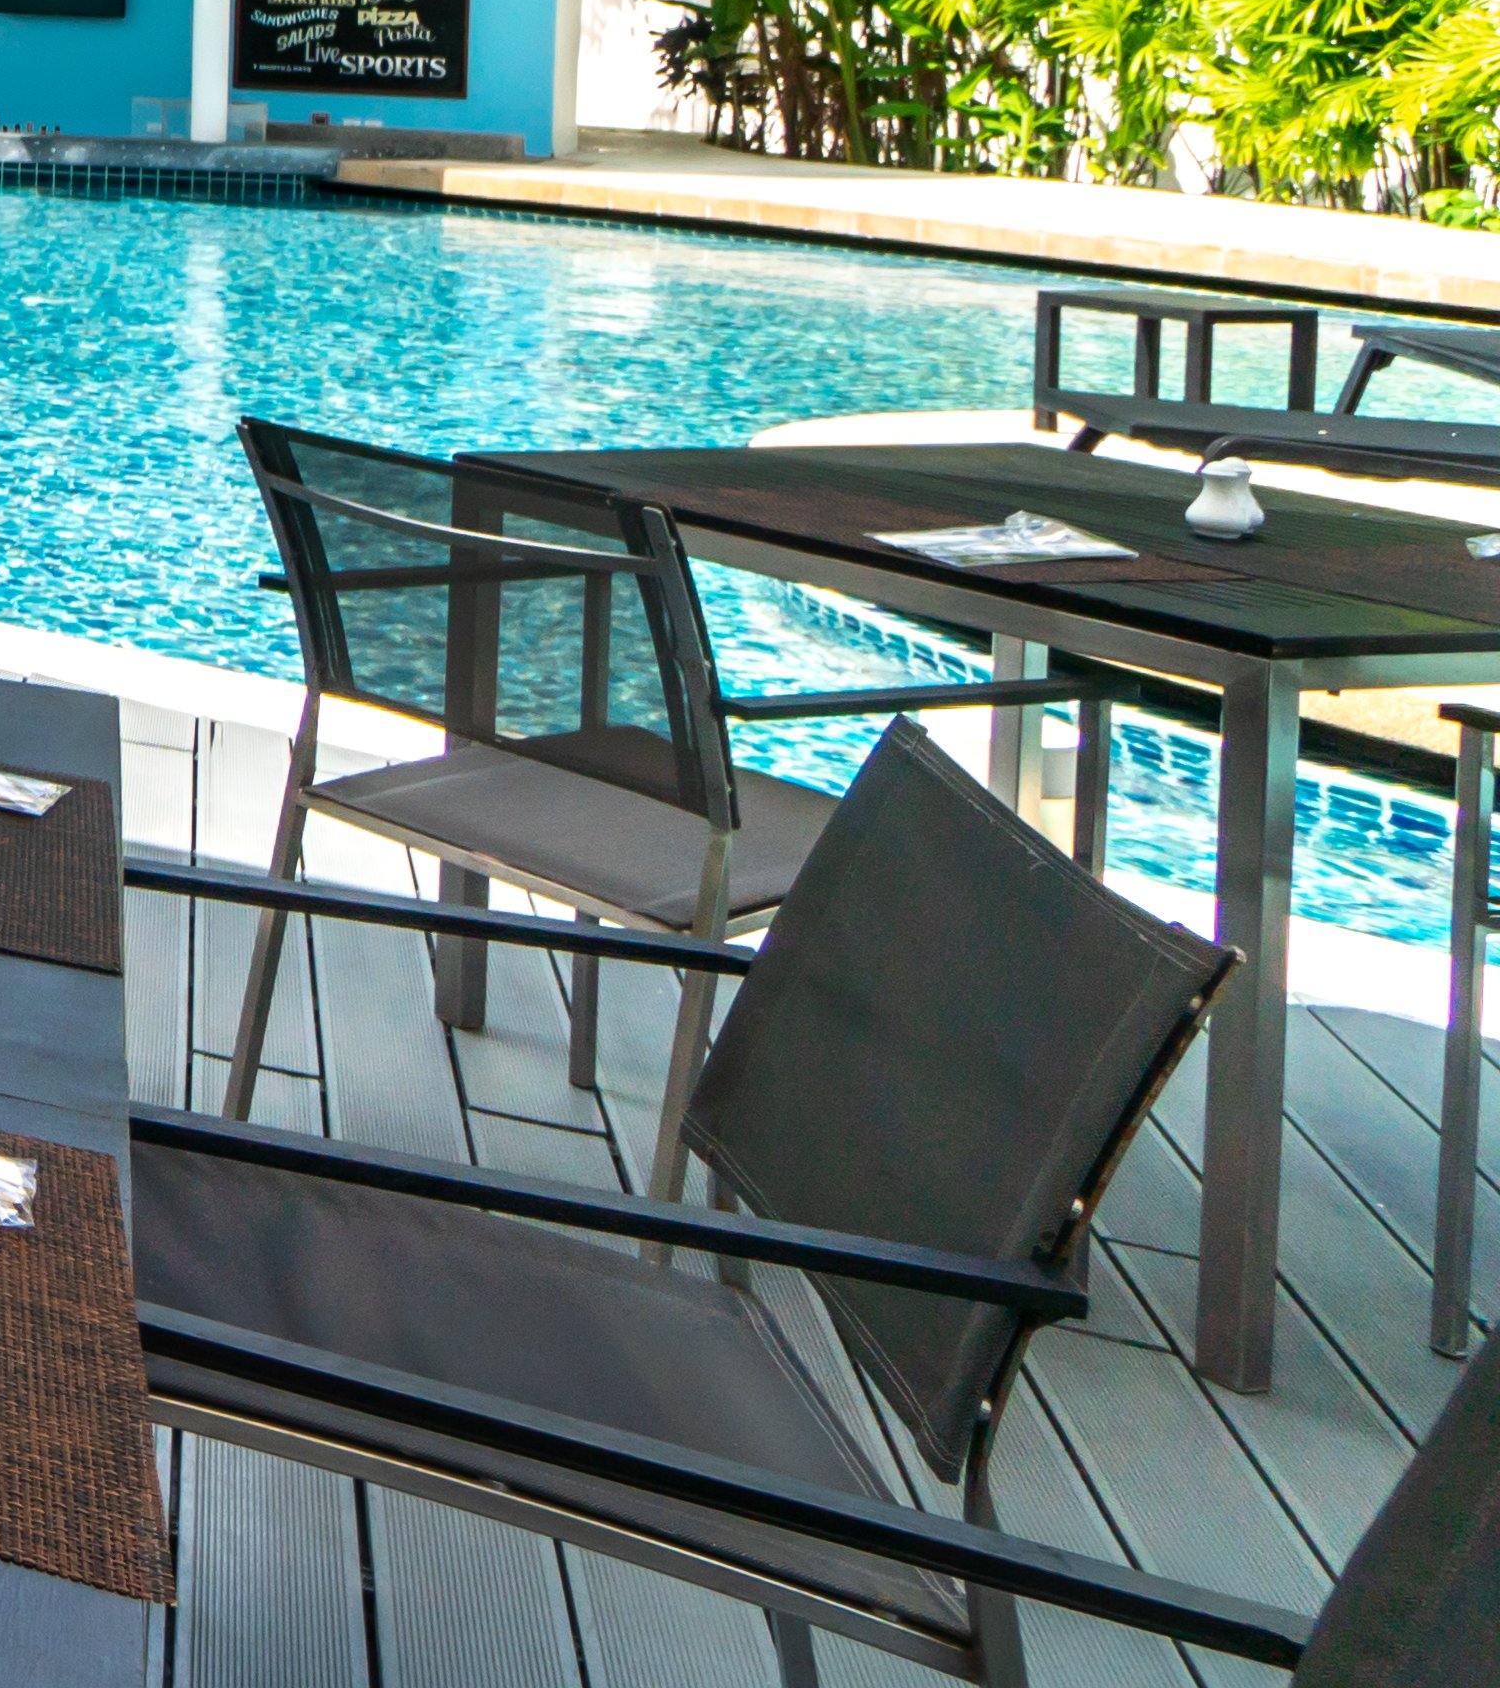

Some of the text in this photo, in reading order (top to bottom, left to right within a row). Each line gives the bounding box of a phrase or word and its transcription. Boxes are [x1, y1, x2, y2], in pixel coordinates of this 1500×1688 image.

[250, 8, 339, 27] SANDWICHES
[276, 23, 337, 52] SALADS
[374, 21, 436, 47] Pasta
[304, 42, 447, 79] Live SPORTS
